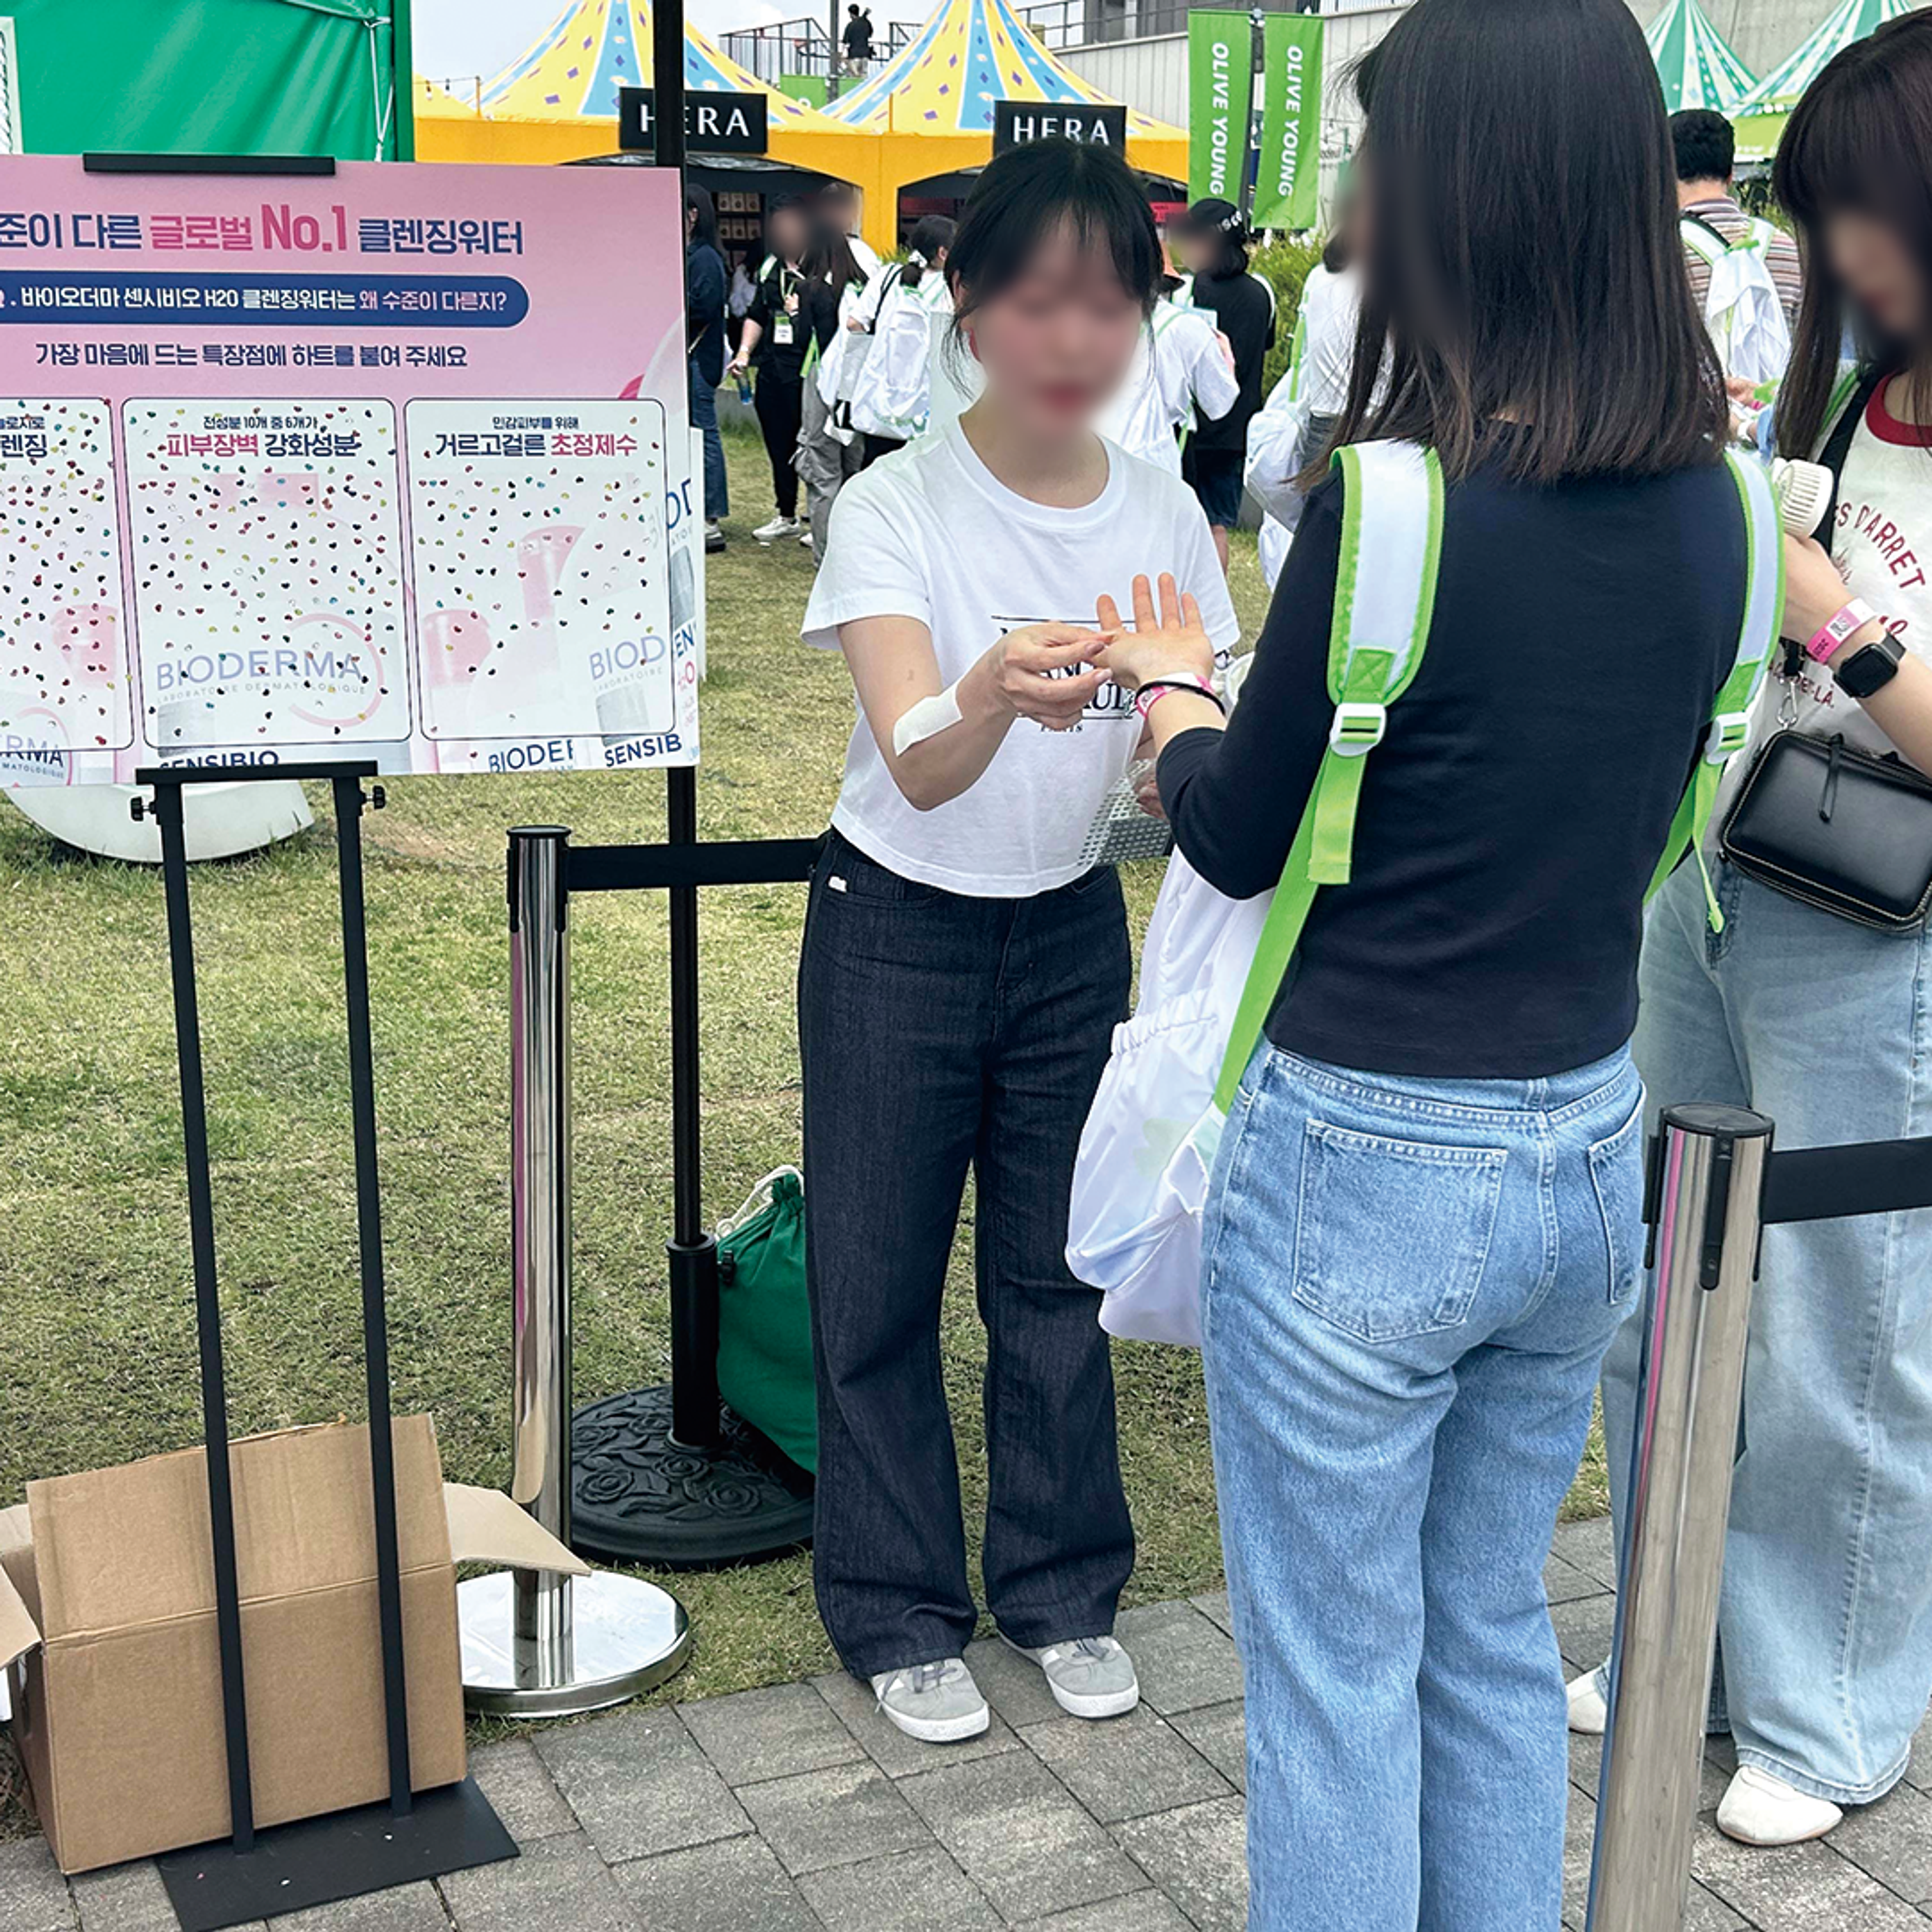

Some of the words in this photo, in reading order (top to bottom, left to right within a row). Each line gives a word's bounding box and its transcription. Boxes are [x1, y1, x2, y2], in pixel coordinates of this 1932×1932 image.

[1212, 42, 1229, 110] OLIVE
[1285, 45, 1303, 113] OLIVE
[1209, 116, 1228, 195] YOUNG
[1278, 119, 1300, 196] YOUNG
[72, 214, 142, 249] 다른
[150, 215, 253, 251] 글로벌
[261, 204, 348, 252] No.1
[358, 219, 523, 255] 클렌징워터
[21, 287, 120, 307] 바이오더마
[124, 287, 201, 308] 센시비오
[243, 289, 356, 310] 클렌징워터는
[359, 290, 378, 310] 왜
[382, 290, 437, 311] 수준이
[442, 291, 507, 311] 다른지?
[36, 343, 81, 366] 가장
[85, 343, 149, 366] 마음에
[155, 344, 197, 366] 드는
[203, 344, 287, 366] 특장점에
[292, 344, 355, 367] 하트를
[360, 345, 400, 367] 붙여
[406, 345, 467, 367] 주세요
[204, 417, 242, 430] 전성분
[244, 417, 268, 429] 10개
[271, 417, 283, 429] 중
[286, 417, 318, 429] 6개가
[554, 417, 579, 430] 위해
[166, 433, 259, 457] 피부장벽
[265, 433, 356, 457] 강화성분
[435, 433, 546, 457] 거르고걸른
[551, 433, 638, 457] 초정제수
[157, 650, 362, 691] BIODERMA
[605, 733, 682, 768] SENSIB
